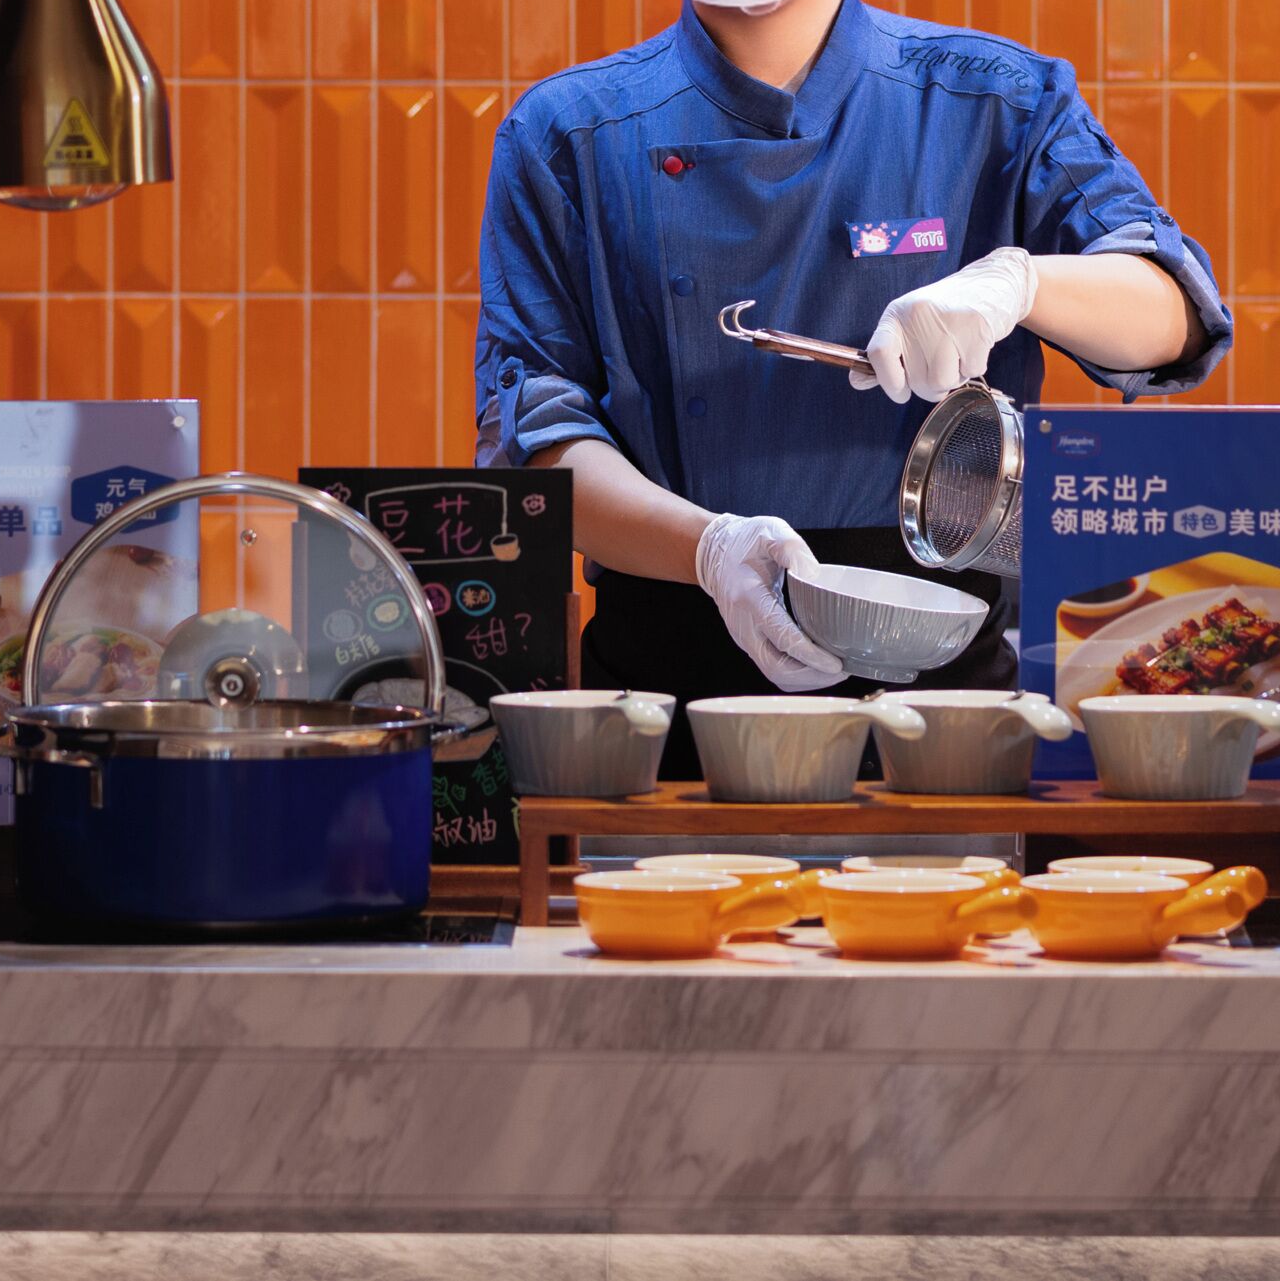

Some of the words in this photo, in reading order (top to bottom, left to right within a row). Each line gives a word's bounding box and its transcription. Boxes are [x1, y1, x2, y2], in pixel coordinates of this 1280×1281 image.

[887, 46, 1029, 88] Hampton
[106, 478, 147, 497] 元气
[1051, 475, 1168, 503] 足不出户
